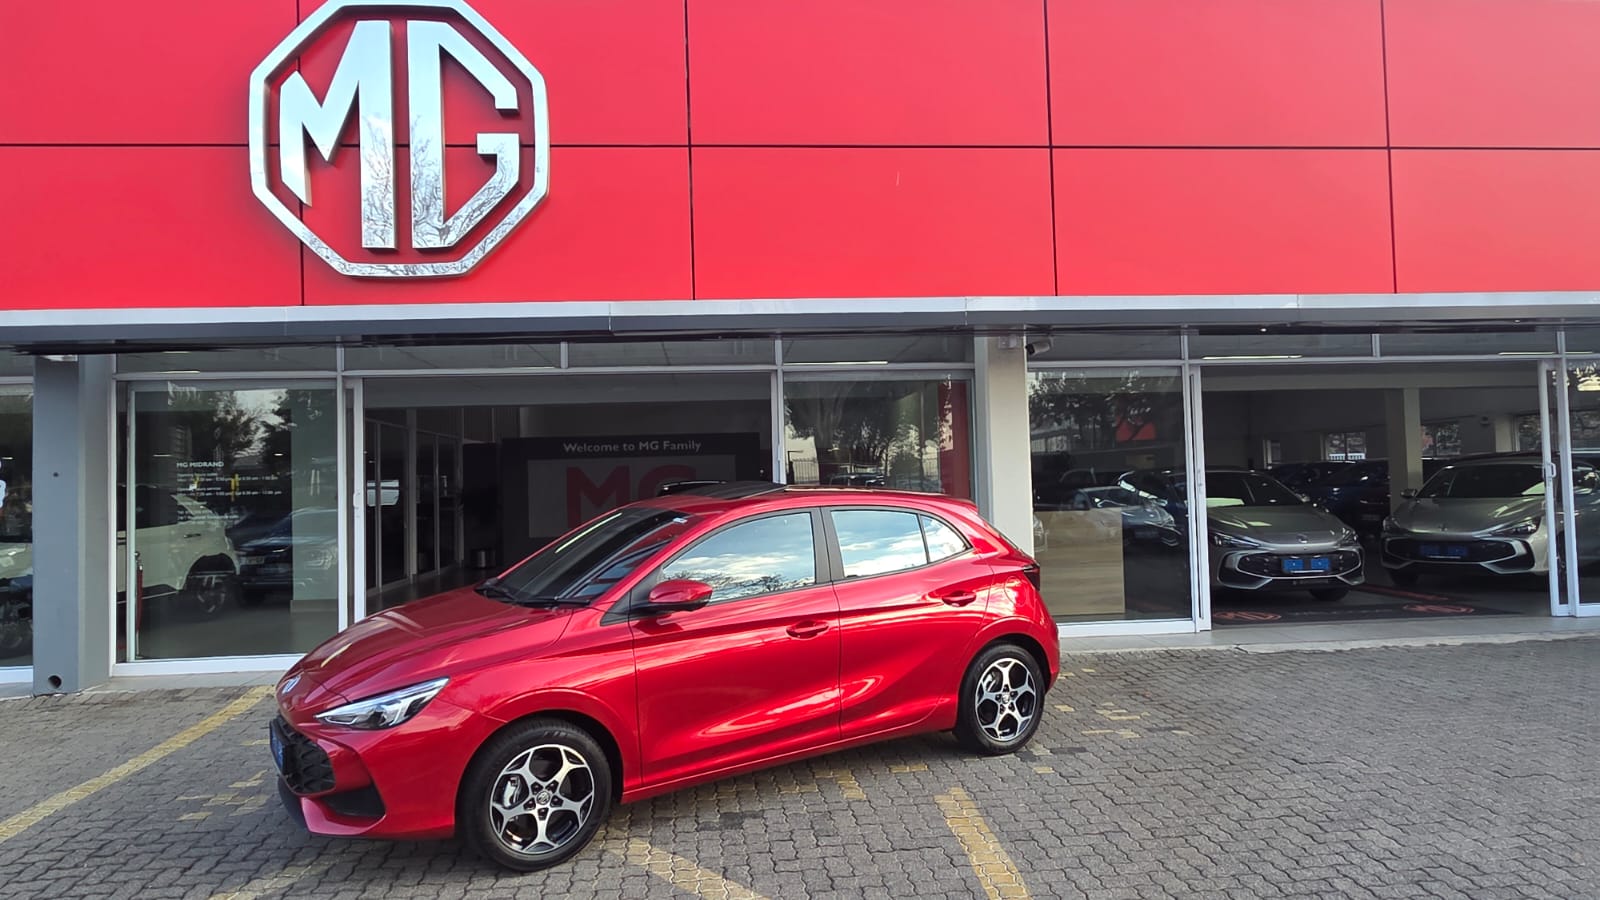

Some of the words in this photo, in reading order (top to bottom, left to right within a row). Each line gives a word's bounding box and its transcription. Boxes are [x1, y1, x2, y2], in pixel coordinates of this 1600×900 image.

[279, 20, 520, 250] MG
[563, 442, 619, 453] Welcome
[623, 442, 635, 451] to
[639, 441, 659, 451] MG
[663, 440, 701, 452] Family
